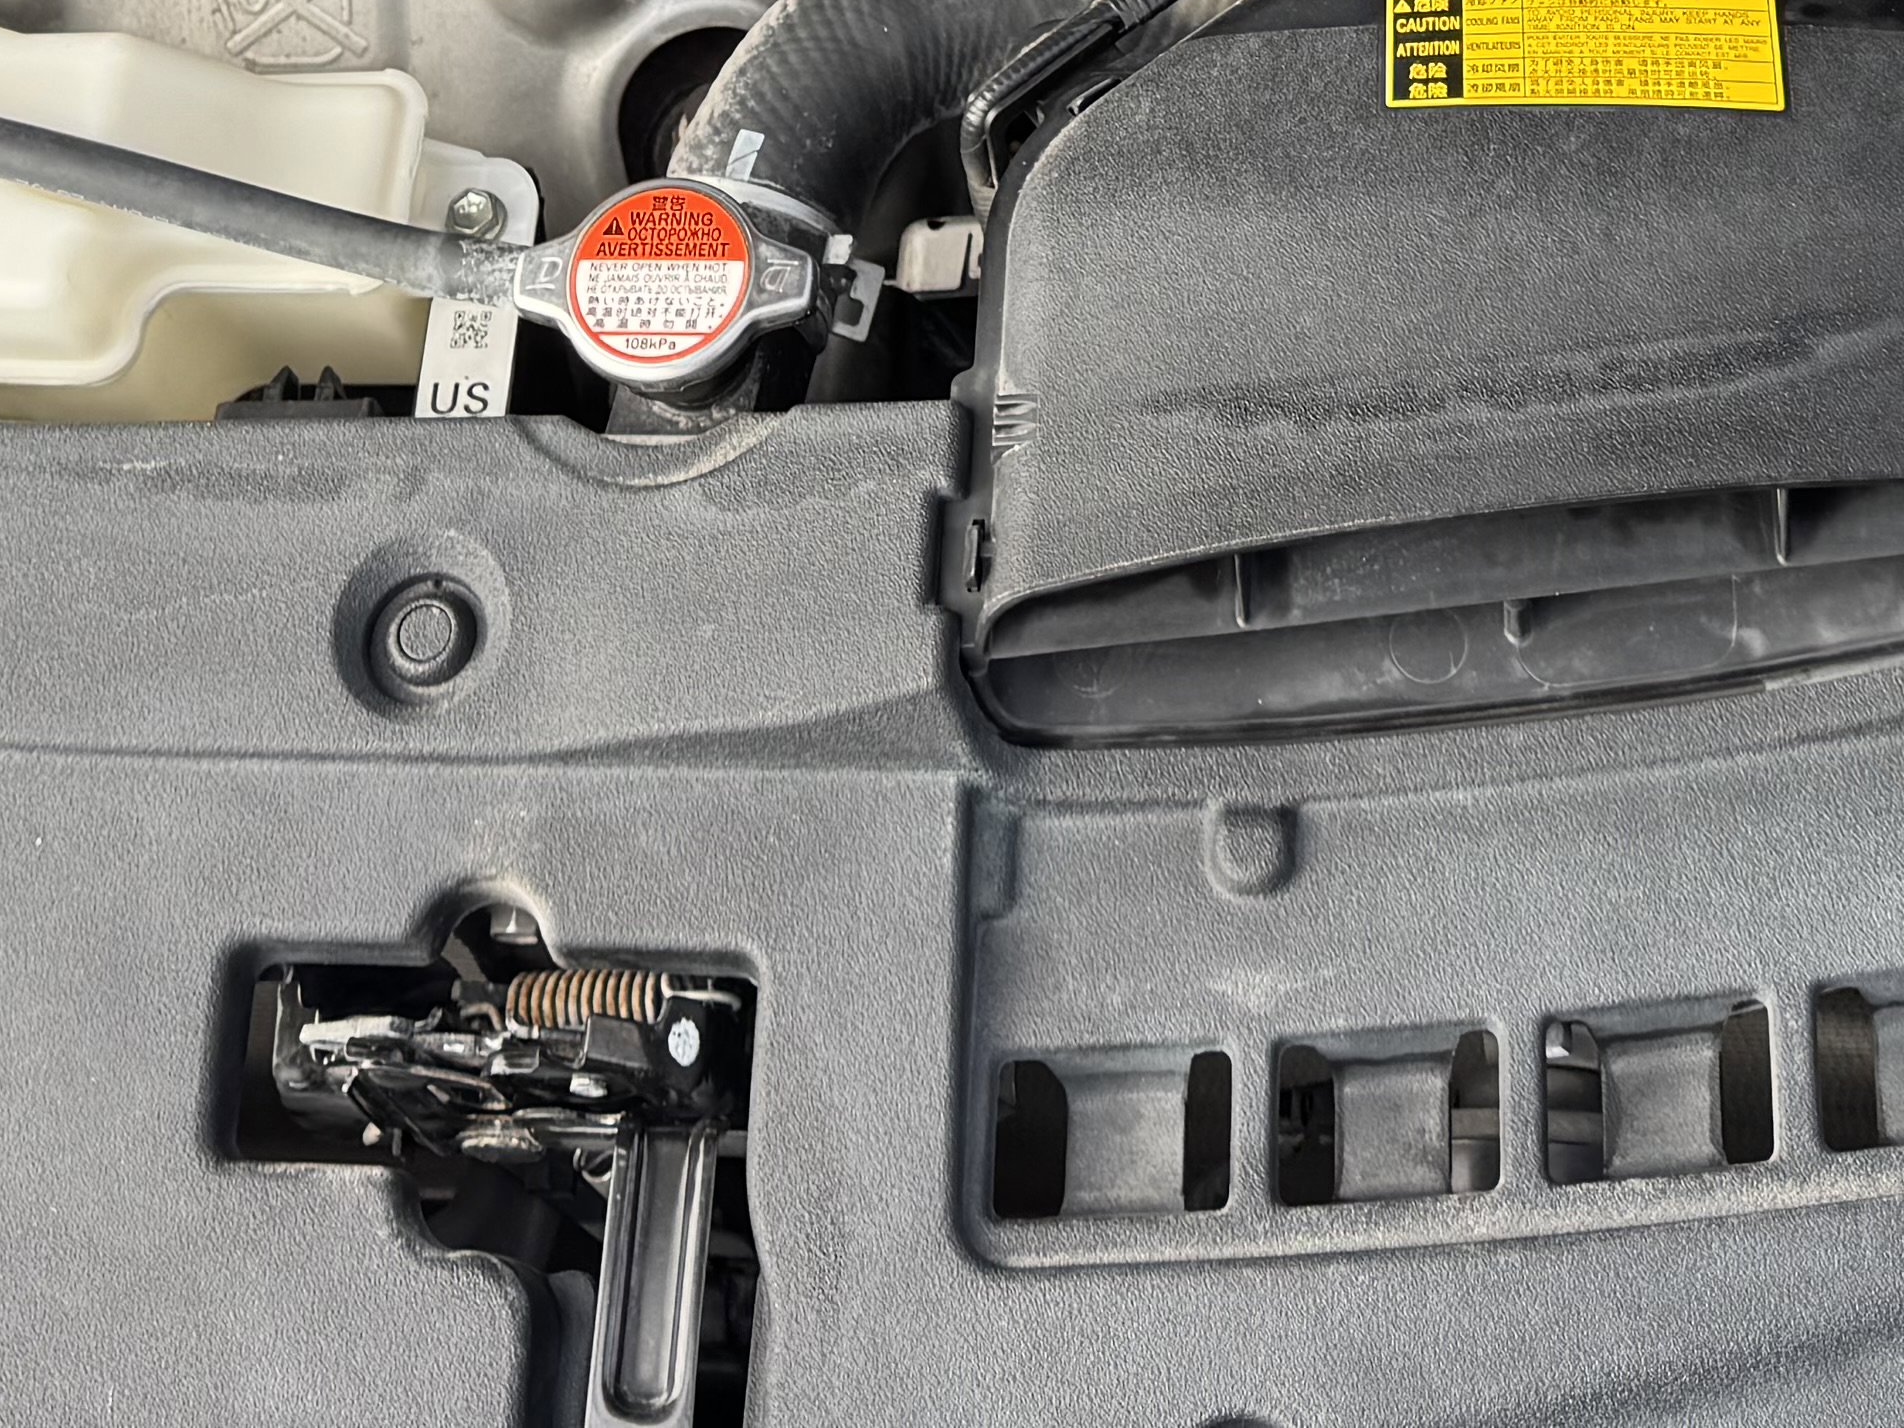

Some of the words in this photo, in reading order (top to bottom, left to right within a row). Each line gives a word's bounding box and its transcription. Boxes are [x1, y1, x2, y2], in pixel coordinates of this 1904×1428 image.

[1396, 16, 1460, 33] CAUTION
[1466, 17, 1498, 27] COOLING
[1501, 16, 1520, 25] FANS
[1396, 40, 1460, 58] ATTENTION
[1409, 62, 1447, 79] 危险
[652, 196, 686, 212] 警告
[630, 211, 713, 227] WARNING
[627, 228, 722, 242] ОСТОРОЖНО
[596, 242, 730, 257] AVERTISSEMENT
[590, 263, 629, 272] NEVER
[632, 263, 662, 272] OPEN
[666, 263, 699, 272] WHEN
[704, 263, 727, 272] HOT
[589, 274, 600, 283] NE
[604, 274, 640, 284] JAMAIS
[644, 274, 681, 283] OUVRIR
[693, 274, 728, 283] CHAUD
[625, 338, 676, 350] 108kPa
[430, 382, 490, 415] US
